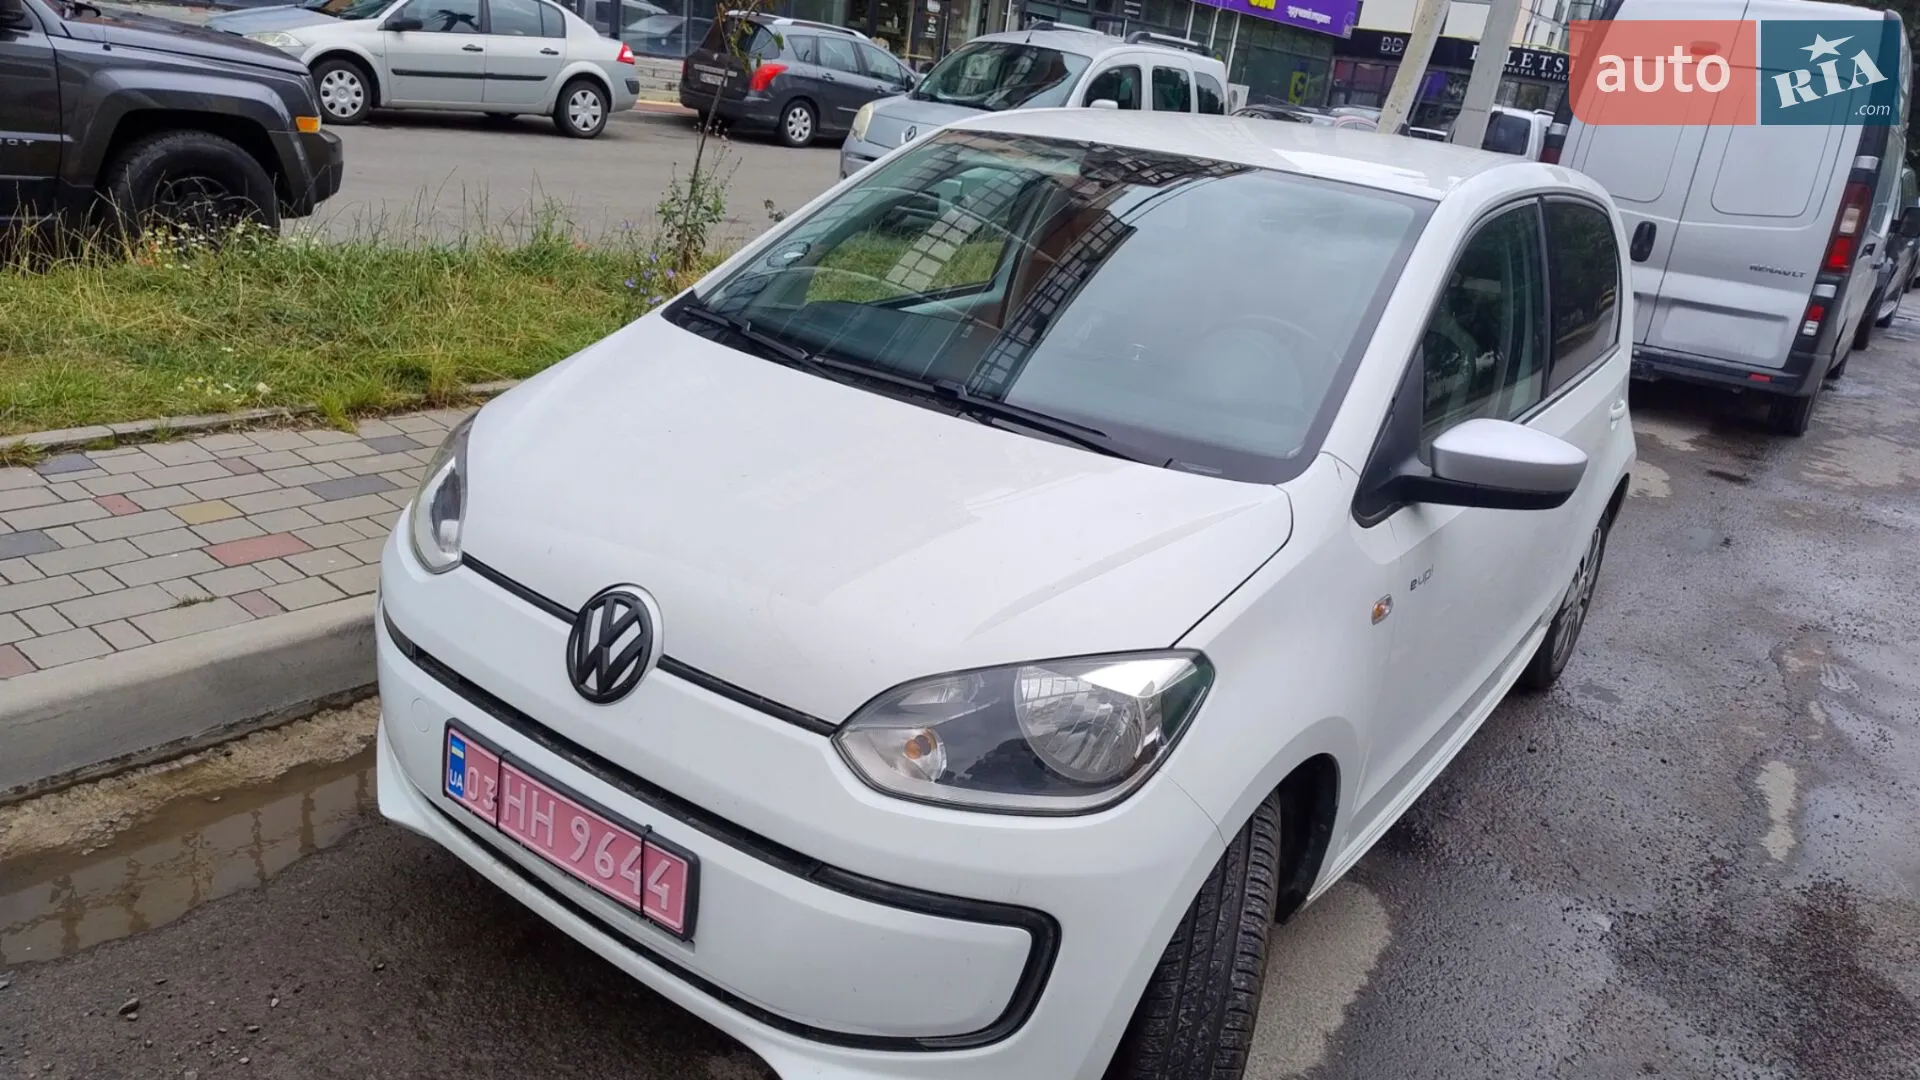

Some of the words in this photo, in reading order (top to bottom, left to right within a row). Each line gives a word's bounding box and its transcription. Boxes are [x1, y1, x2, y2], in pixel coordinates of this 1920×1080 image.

[1541, 71, 1570, 80] OFFIC
[1749, 265, 1807, 278] RENAULT
[450, 769, 464, 792] UA
[569, 815, 671, 910] 9644
